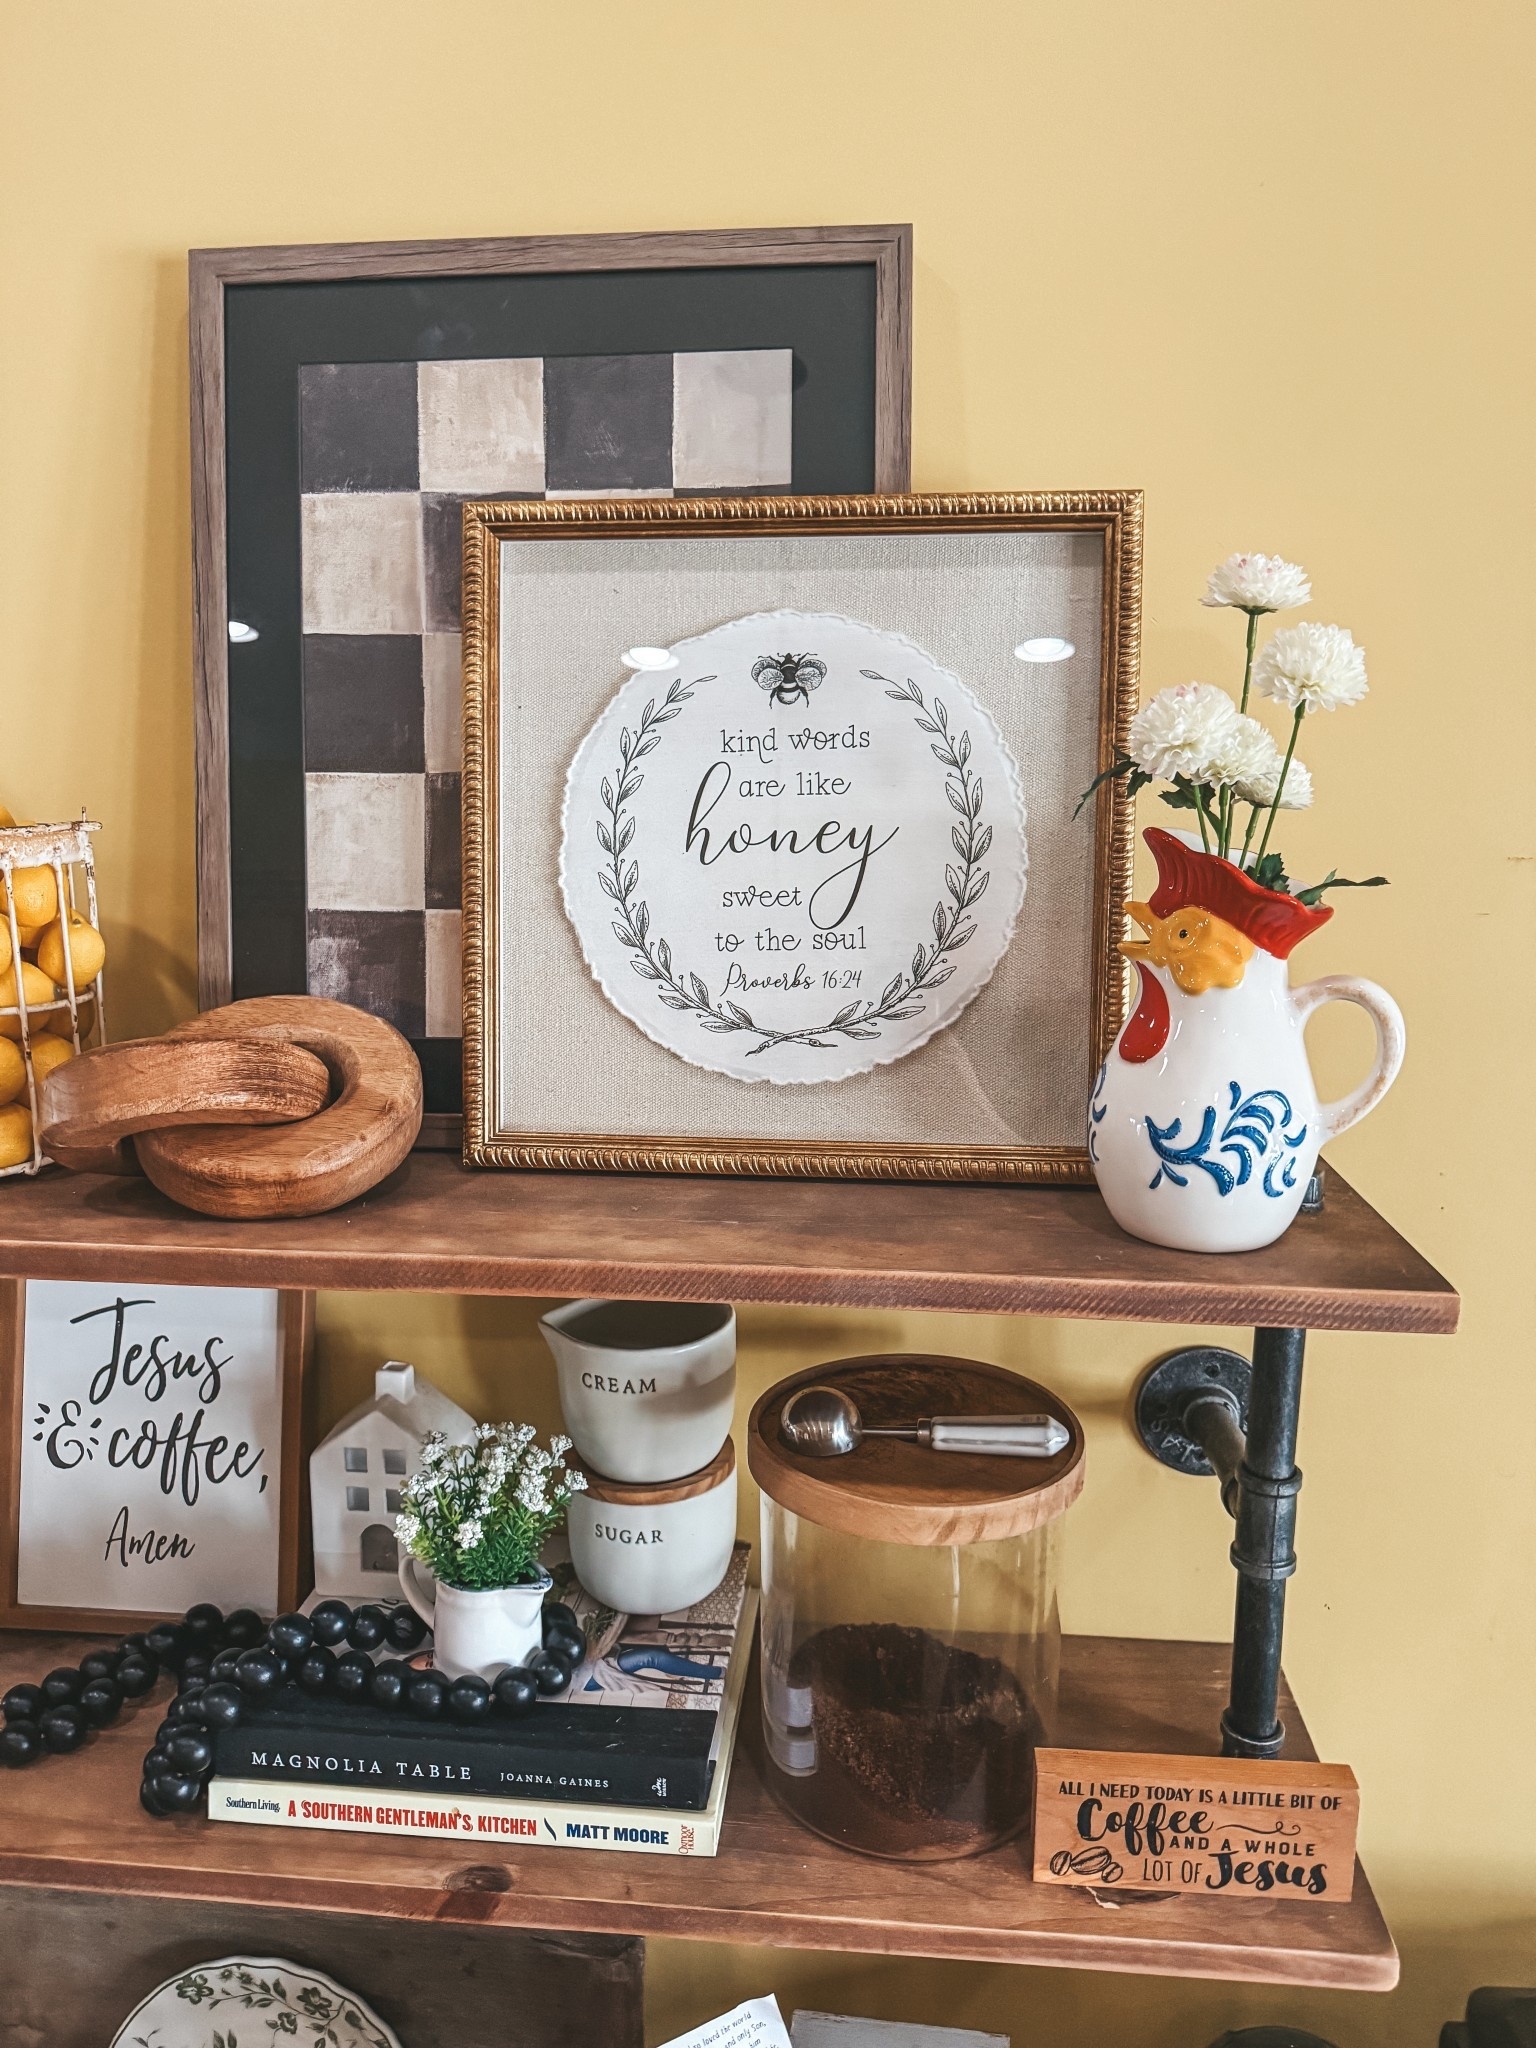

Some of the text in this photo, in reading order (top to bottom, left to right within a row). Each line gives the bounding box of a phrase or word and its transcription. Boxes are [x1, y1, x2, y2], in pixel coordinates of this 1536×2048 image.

[720, 725, 870, 764] kind words
[739, 772, 851, 798] are like
[684, 761, 900, 931] honey
[722, 885, 802, 908] sweet
[715, 926, 867, 952] to the soul
[720, 962, 862, 996] Proverbs 16:24
[70, 1297, 234, 1405] Jesus
[582, 1372, 657, 1395] CREAM
[47, 1400, 269, 1507] & coffee,
[104, 1506, 195, 1567] Amen
[595, 1523, 664, 1545] SUGAR
[251, 1751, 471, 1780] MAGNOLIA TABLE
[500, 1772, 610, 1788] JOANNA GAINES
[226, 1796, 257, 1809] Southern
[1058, 1781, 1342, 1811] ALL I NEED TODAY IS A LITTLE BIT OF
[288, 1800, 537, 1836] A SOUTHERN GENTLEMAN'S KITCHEN
[1077, 1798, 1214, 1856] Coffee
[566, 1823, 669, 1845] MATT MOORE
[1169, 1836, 1316, 1857] AND A WHOLE
[1143, 1849, 1327, 1895] LOT OF Jesus
[702, 2029, 720, 2046] loved
[732, 2011, 752, 2028] world
[736, 2028, 752, 2042] only
